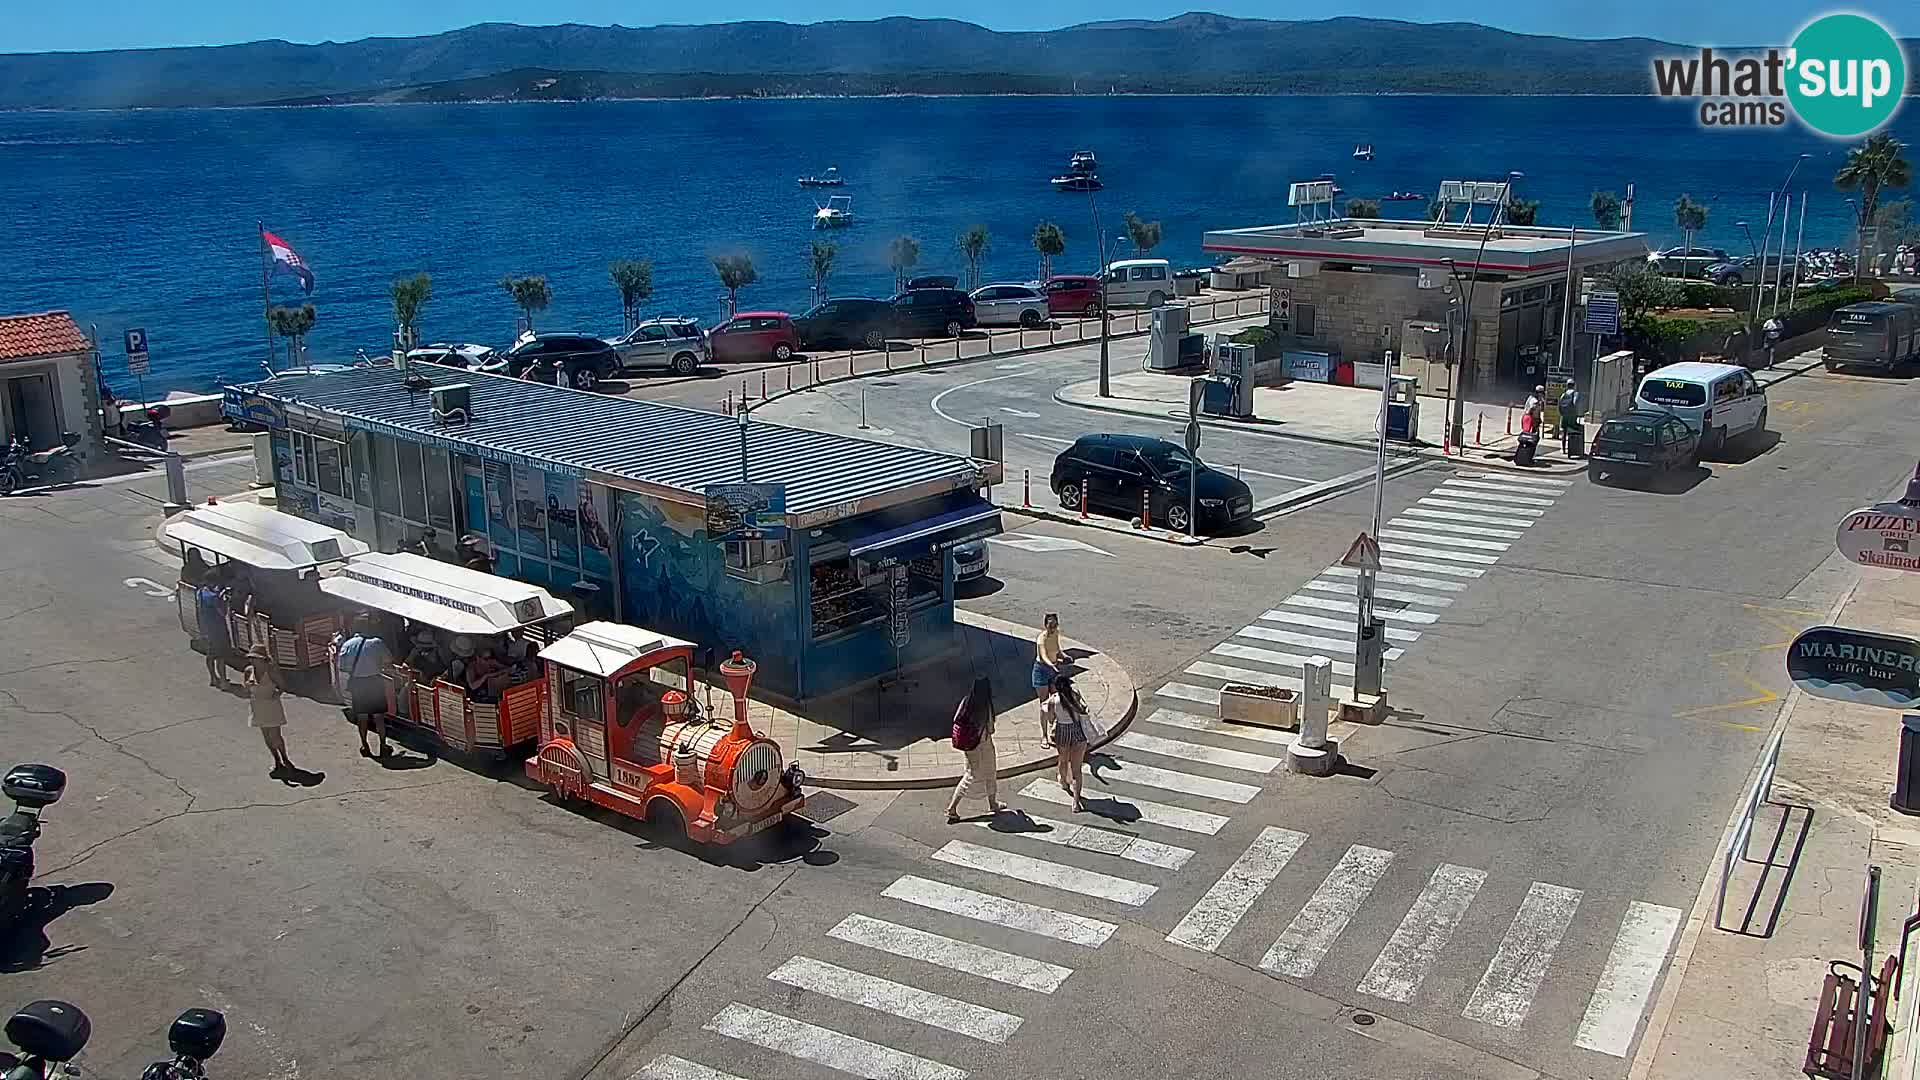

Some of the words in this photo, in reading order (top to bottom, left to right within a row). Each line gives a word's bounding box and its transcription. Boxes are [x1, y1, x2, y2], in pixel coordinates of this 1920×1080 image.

[129, 331, 142, 350] P
[1665, 381, 1684, 389] TAXI
[478, 447, 492, 458] BUS
[493, 450, 525, 465] STATION
[527, 458, 553, 472] TICKET
[1848, 515, 1920, 534] PIZZE
[1880, 530, 1916, 540] GRILL
[383, 579, 401, 593] BEACH
[439, 595, 452, 607] BOL
[453, 599, 477, 614] CENTER
[1827, 660, 1864, 674] caffe
[1869, 666, 1896, 680] bar
